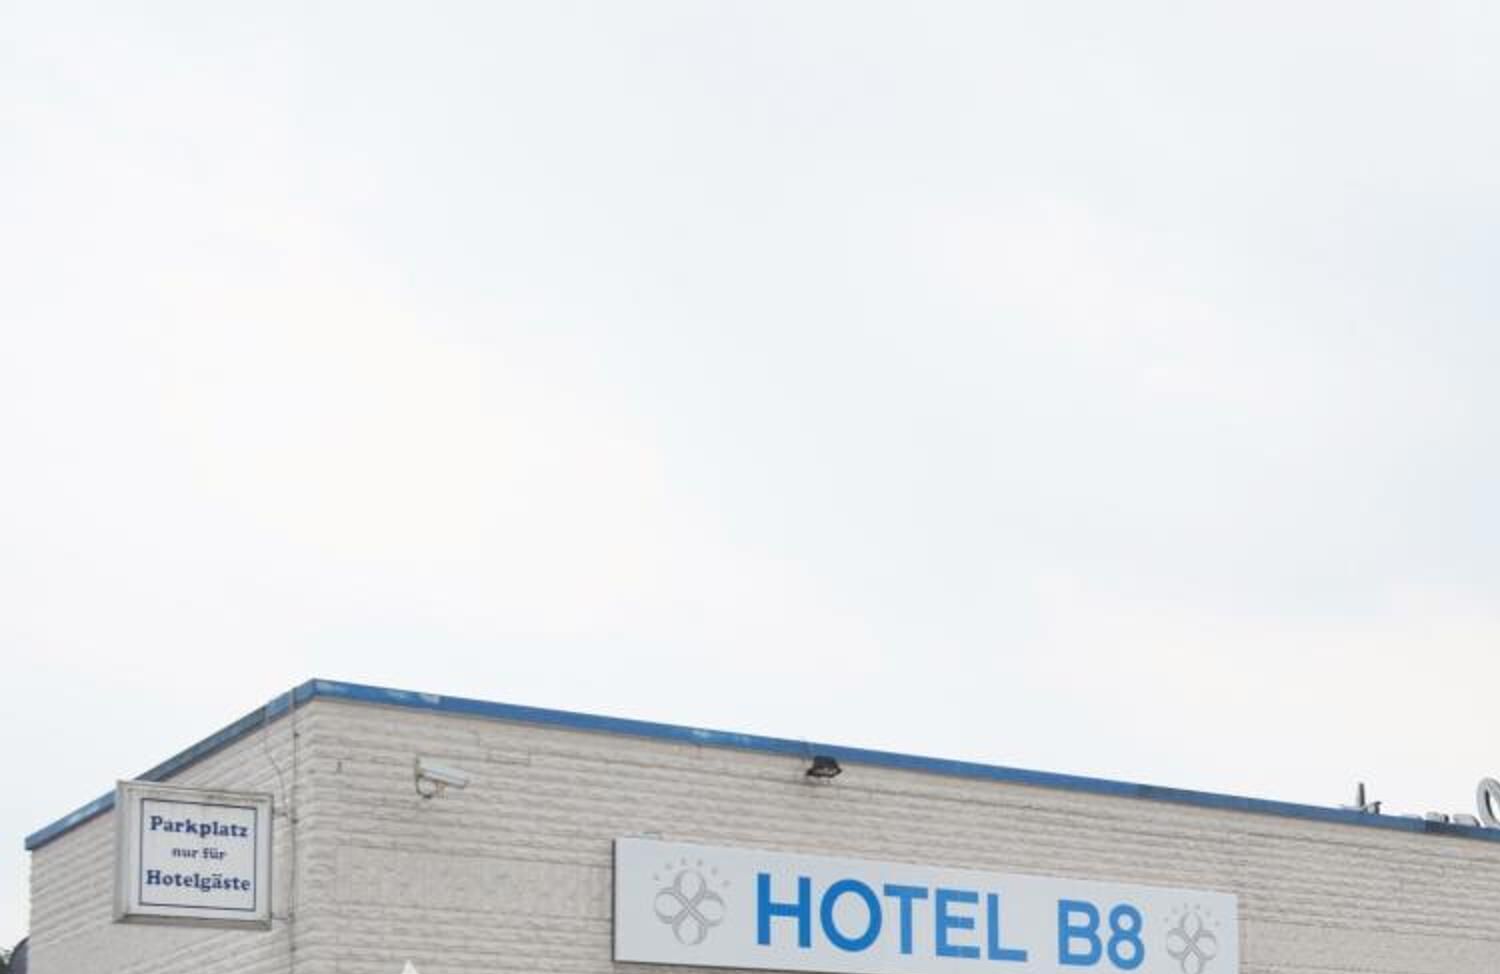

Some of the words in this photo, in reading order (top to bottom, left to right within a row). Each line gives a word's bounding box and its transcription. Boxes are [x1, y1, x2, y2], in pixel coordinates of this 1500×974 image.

[149, 815, 249, 838] Parkplatz
[171, 847, 199, 858] nur
[201, 847, 227, 860] für
[145, 869, 251, 892] Hotelgäste
[756, 872, 1029, 962] HOTEL
[1057, 899, 1146, 971] B8
